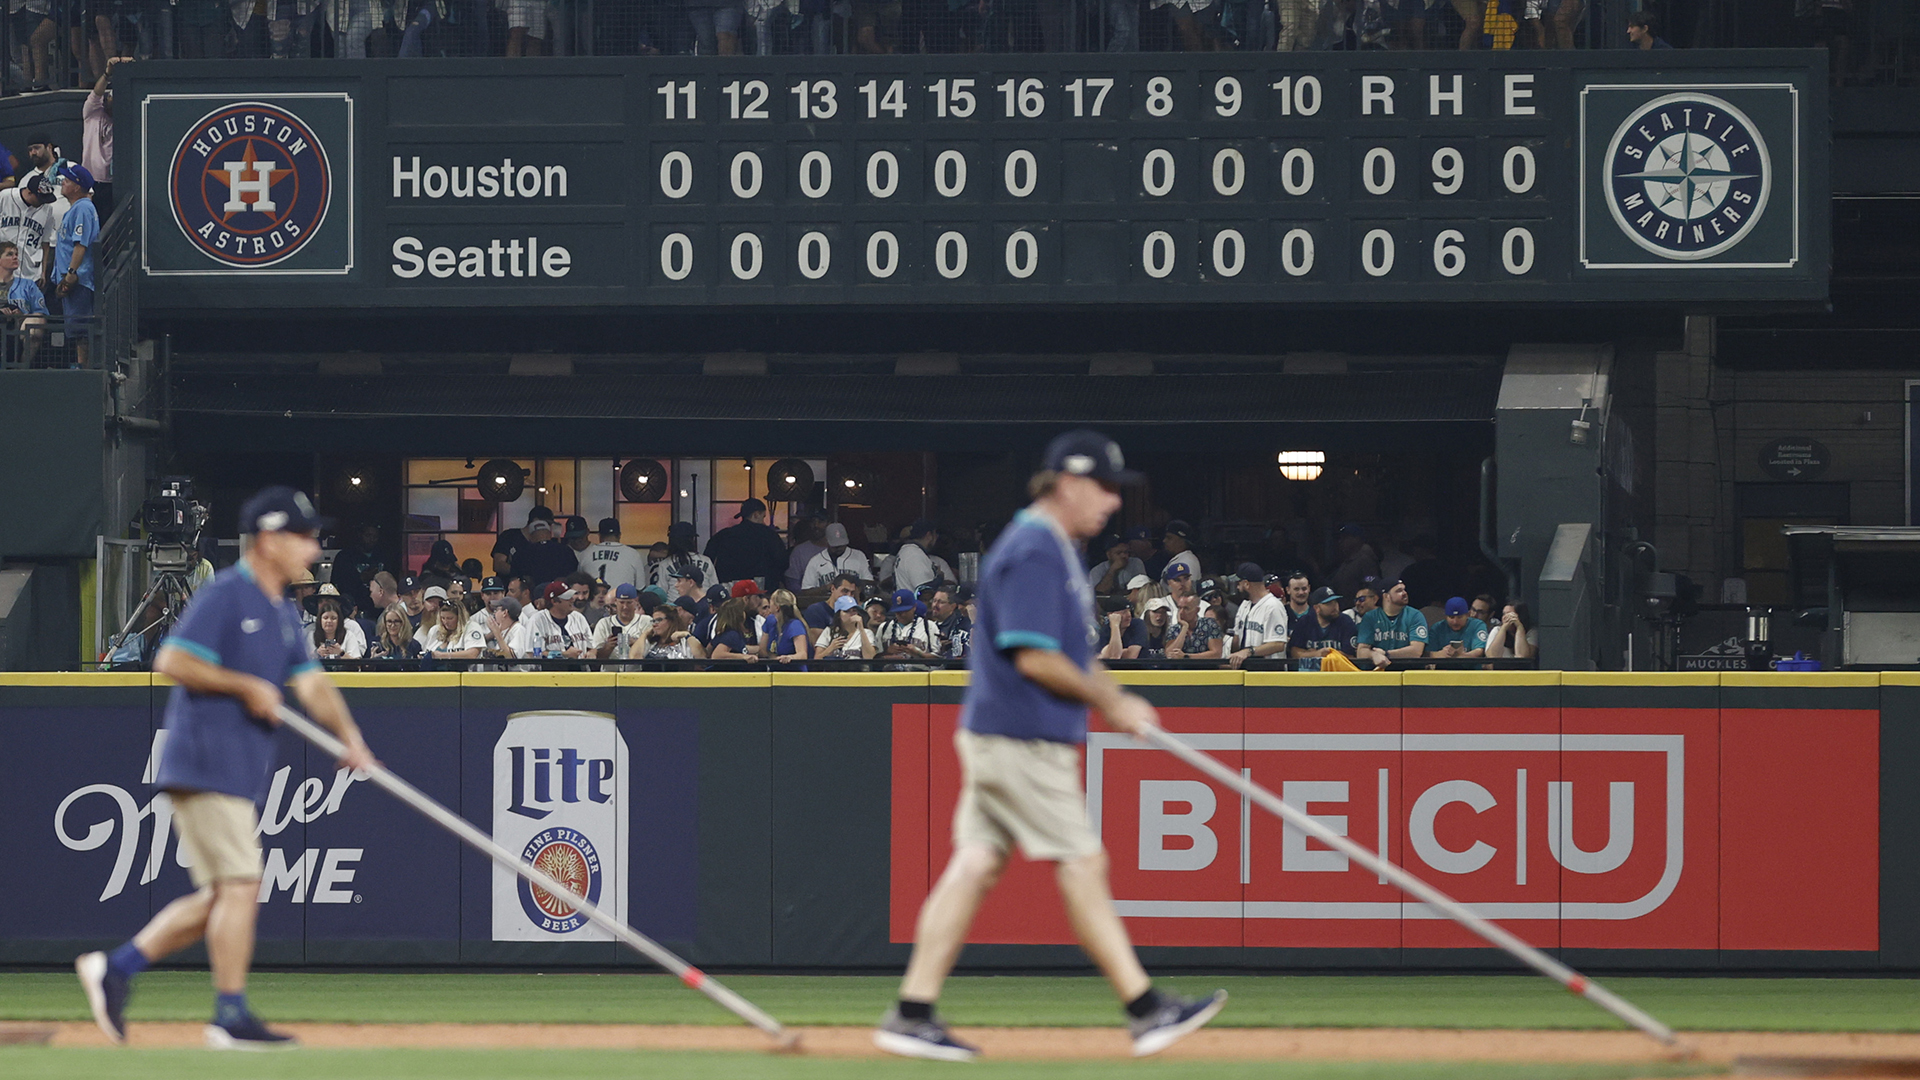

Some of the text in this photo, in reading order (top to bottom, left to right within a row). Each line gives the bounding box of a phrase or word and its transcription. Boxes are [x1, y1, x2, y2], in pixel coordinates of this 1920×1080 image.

[657, 74, 1536, 120] 11 12 13 14 15 16 17 8 9 10 R H E
[192, 114, 308, 159] HOUSTON
[1624, 109, 1750, 161] SEATTLE
[223, 161, 277, 212] H
[392, 145, 1536, 199] Houston 0 0 0 0 0 0 0 0 0 0 9 0
[197, 219, 301, 256] ASTROS
[1623, 190, 1752, 244] MARINERS
[26, 233, 41, 249] 24
[391, 227, 1535, 281] Seattle 0 0 0 0 0 0 0 0 0 0 6 0
[592, 550, 620, 562] LEWIS
[487, 577, 495, 587] S
[507, 746, 614, 820] Lite
[525, 829, 600, 874] FINE PILSNER
[541, 917, 580, 932] BEER
